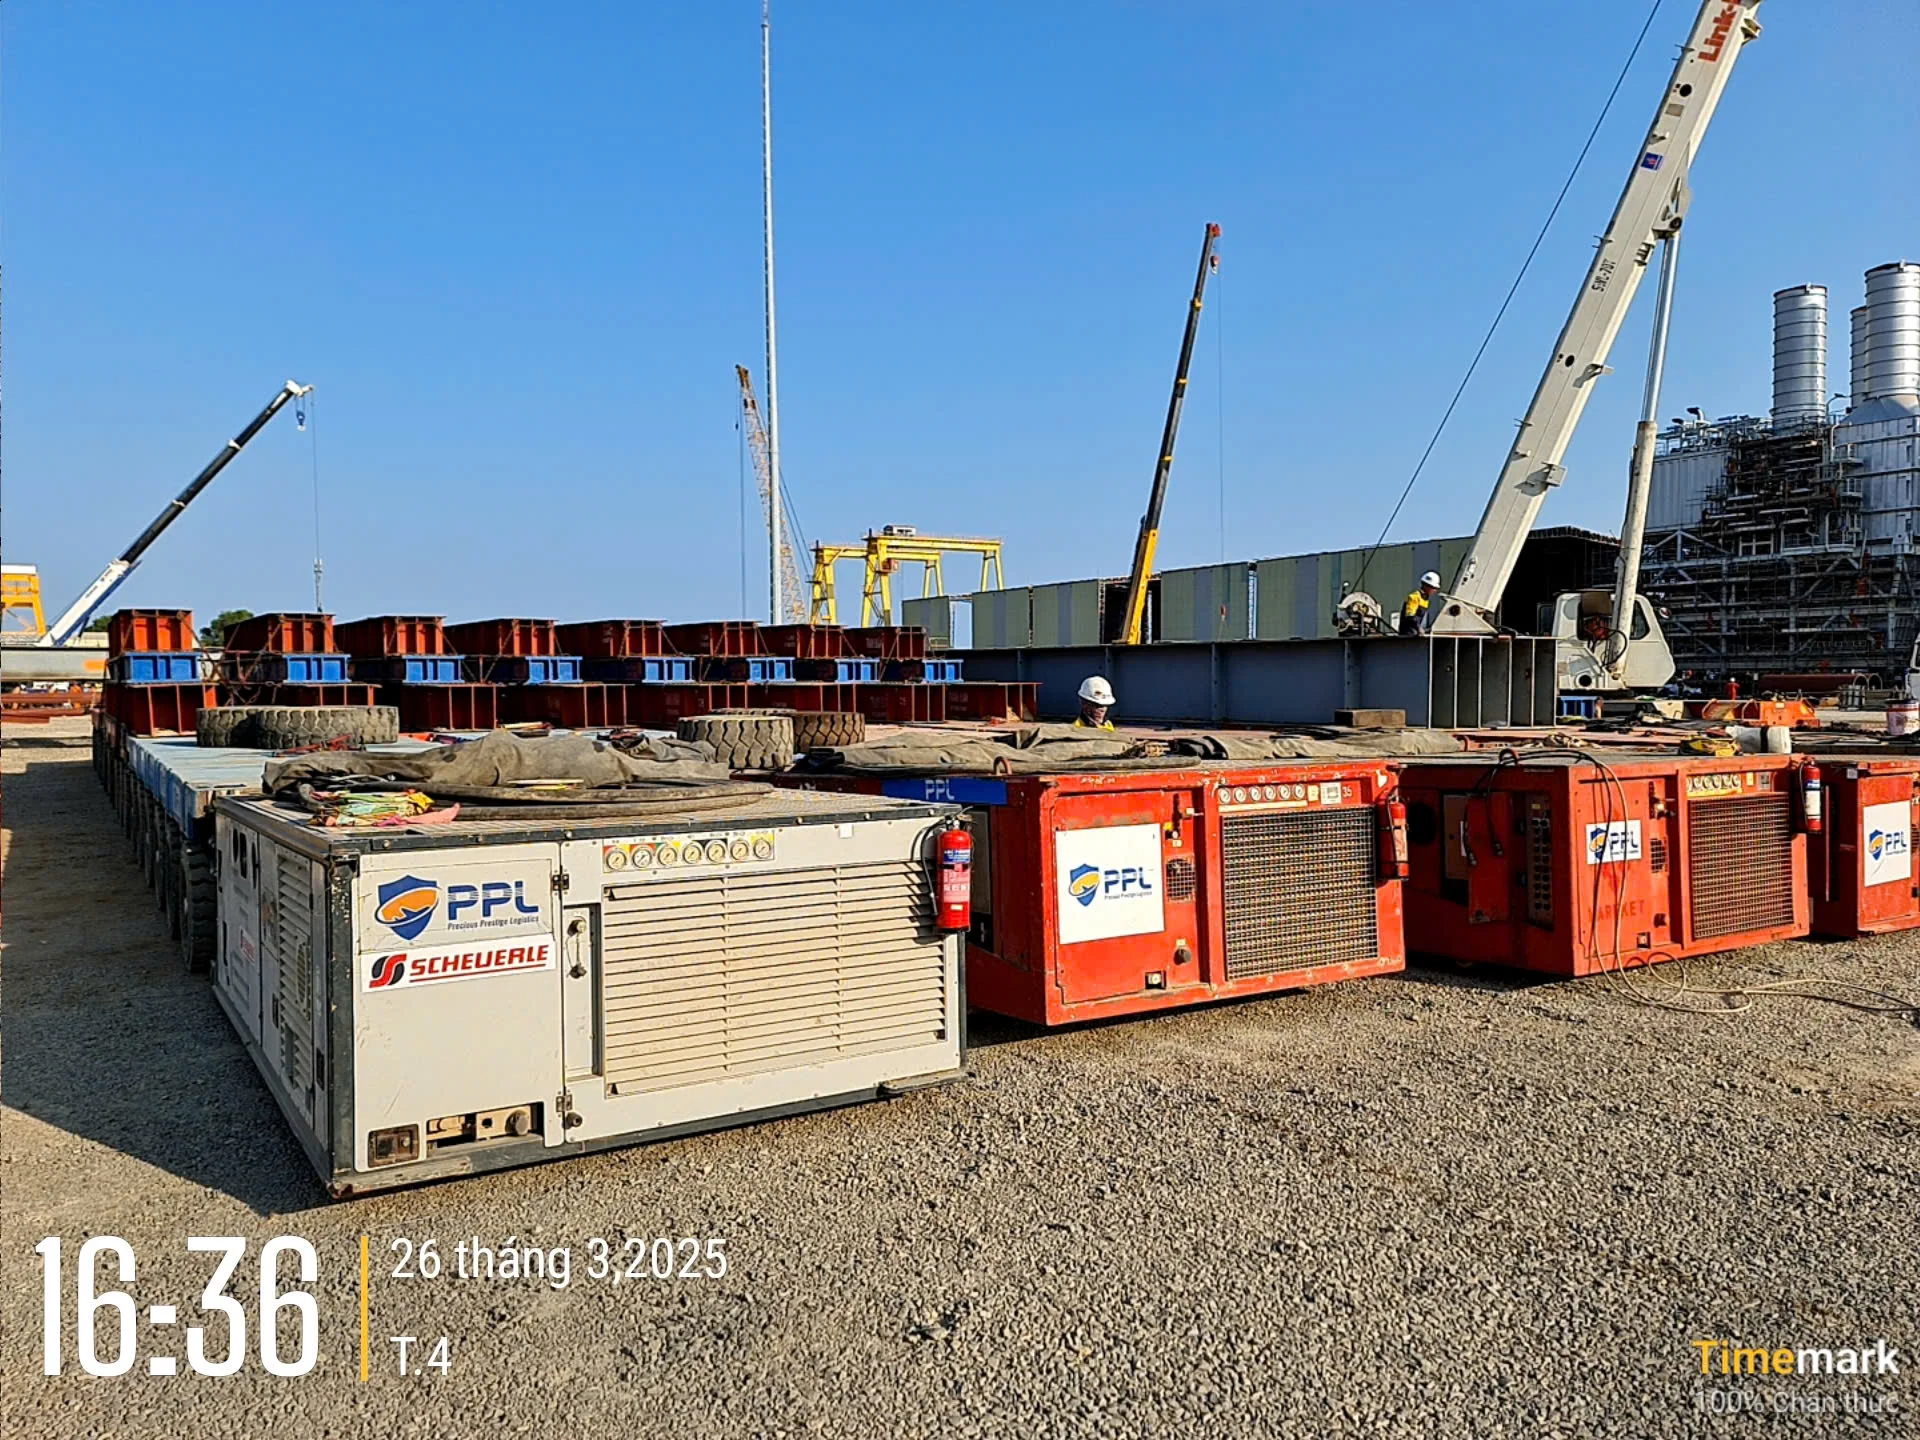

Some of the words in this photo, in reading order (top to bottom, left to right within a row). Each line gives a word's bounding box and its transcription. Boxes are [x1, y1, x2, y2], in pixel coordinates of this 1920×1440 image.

[1697, 0, 1741, 63] Link-
[924, 779, 955, 800] PPL
[1885, 831, 1907, 851] PPL
[1104, 867, 1152, 894] PPL
[447, 880, 539, 920] PPL
[447, 921, 479, 931] Precious
[479, 918, 508, 929] Prestige
[509, 915, 540, 926] Logistics
[410, 944, 549, 977] SCHEUERLE
